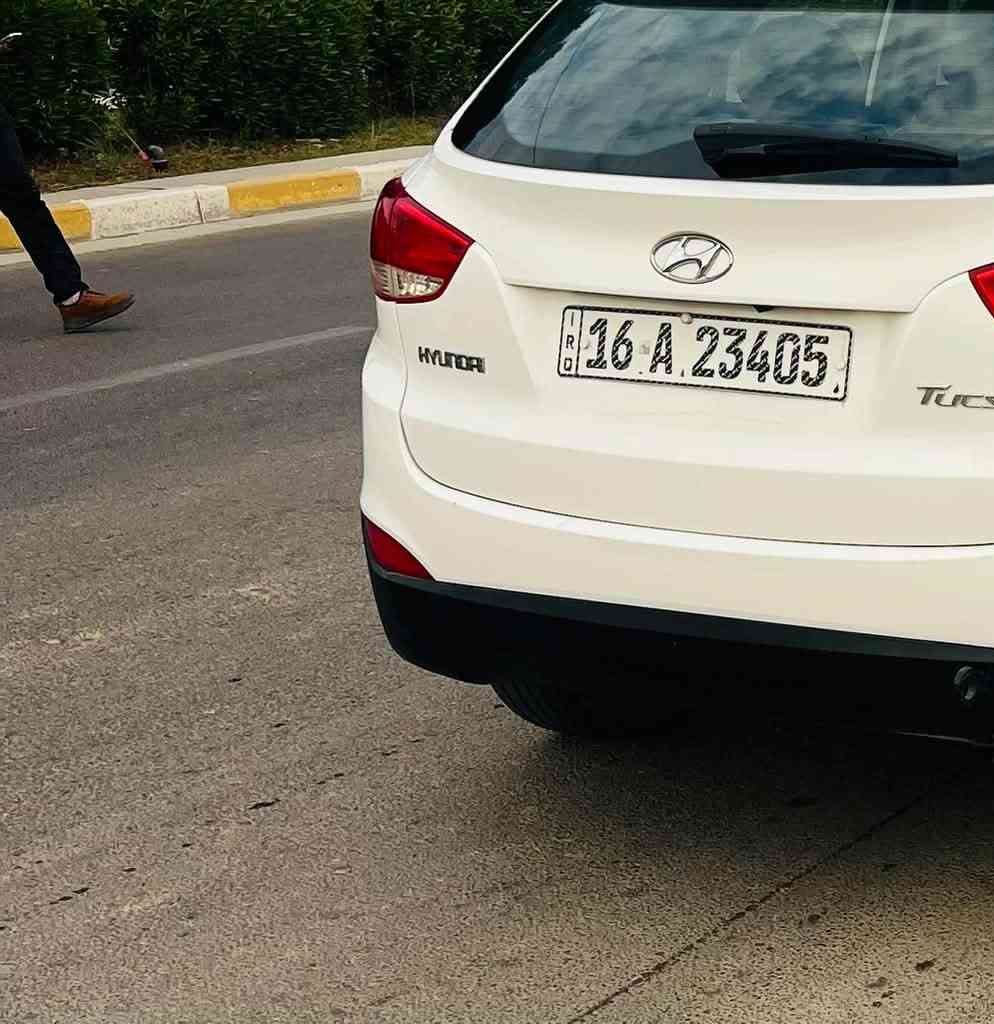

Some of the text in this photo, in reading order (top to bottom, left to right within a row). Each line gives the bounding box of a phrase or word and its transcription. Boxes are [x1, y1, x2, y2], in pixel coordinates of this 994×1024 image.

[417, 345, 486, 374] HYUNDAI
[563, 310, 576, 373] IRQ
[585, 317, 829, 388] 16 A 23405
